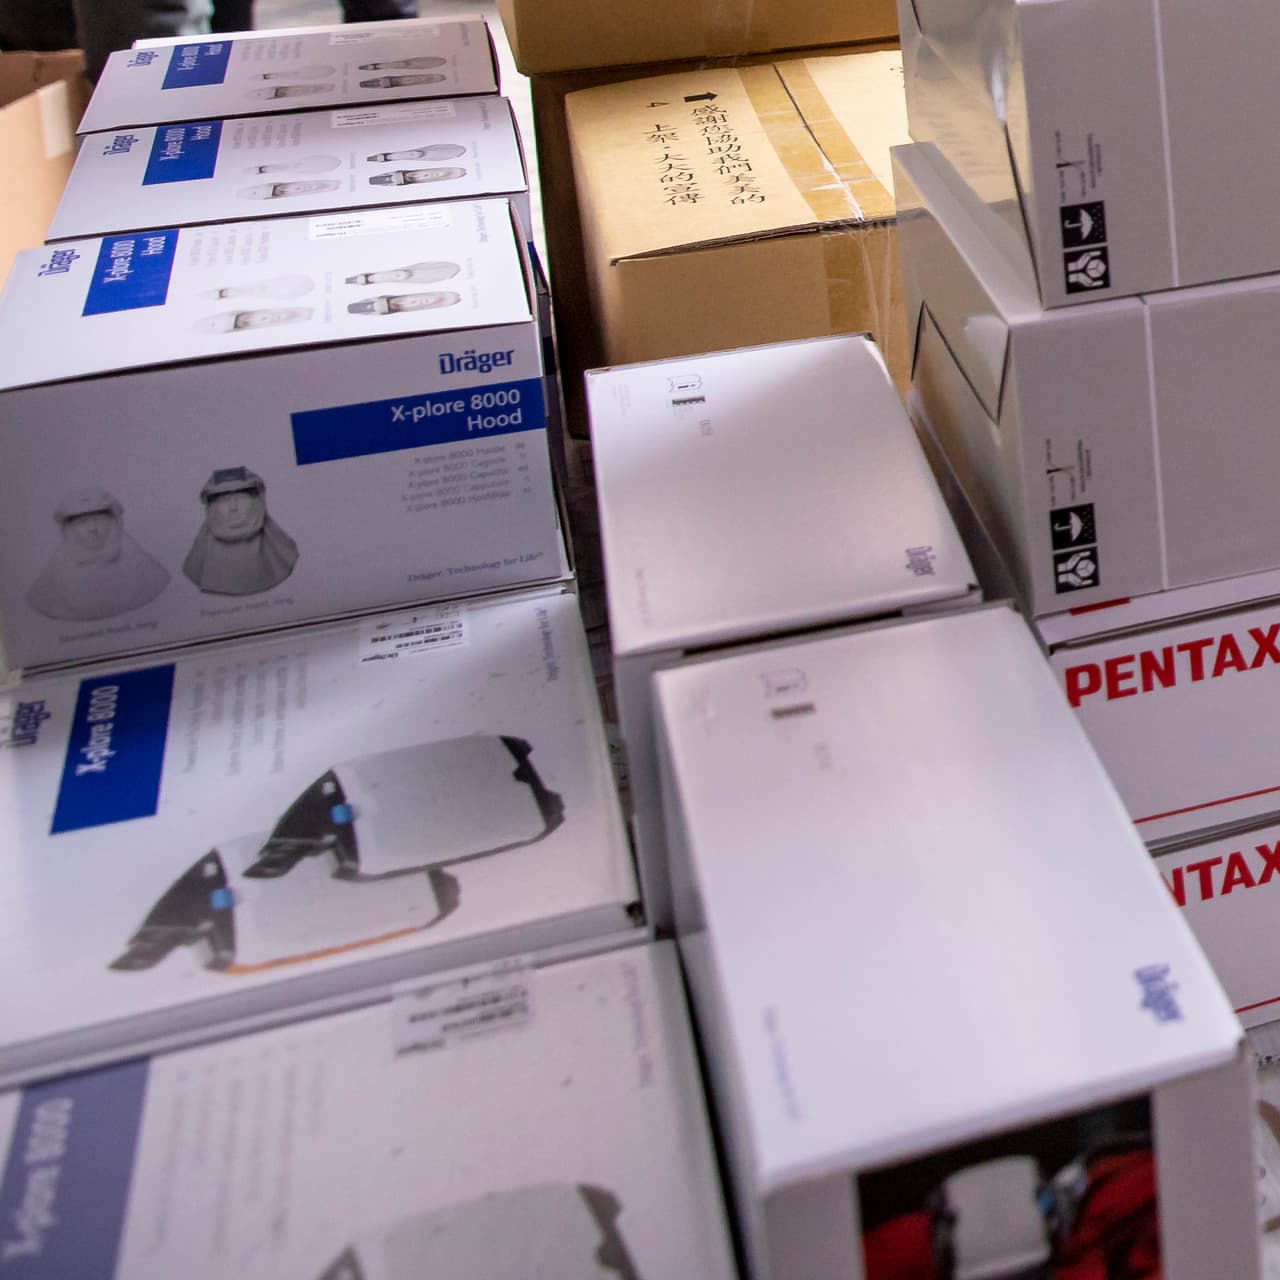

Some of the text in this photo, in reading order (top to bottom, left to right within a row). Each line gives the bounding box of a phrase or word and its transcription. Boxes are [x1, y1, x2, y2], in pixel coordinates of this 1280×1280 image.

[159, 127, 186, 161] X-plore 8000
[190, 125, 212, 140] Hood
[141, 236, 166, 256] Hood
[37, 248, 80, 277] Dräger
[103, 239, 135, 283] X-plore 8000
[438, 349, 515, 375] Dräger
[391, 388, 521, 423] X-plore 8000
[467, 408, 522, 431] Hood
[75, 685, 120, 776] X-plore 8000
